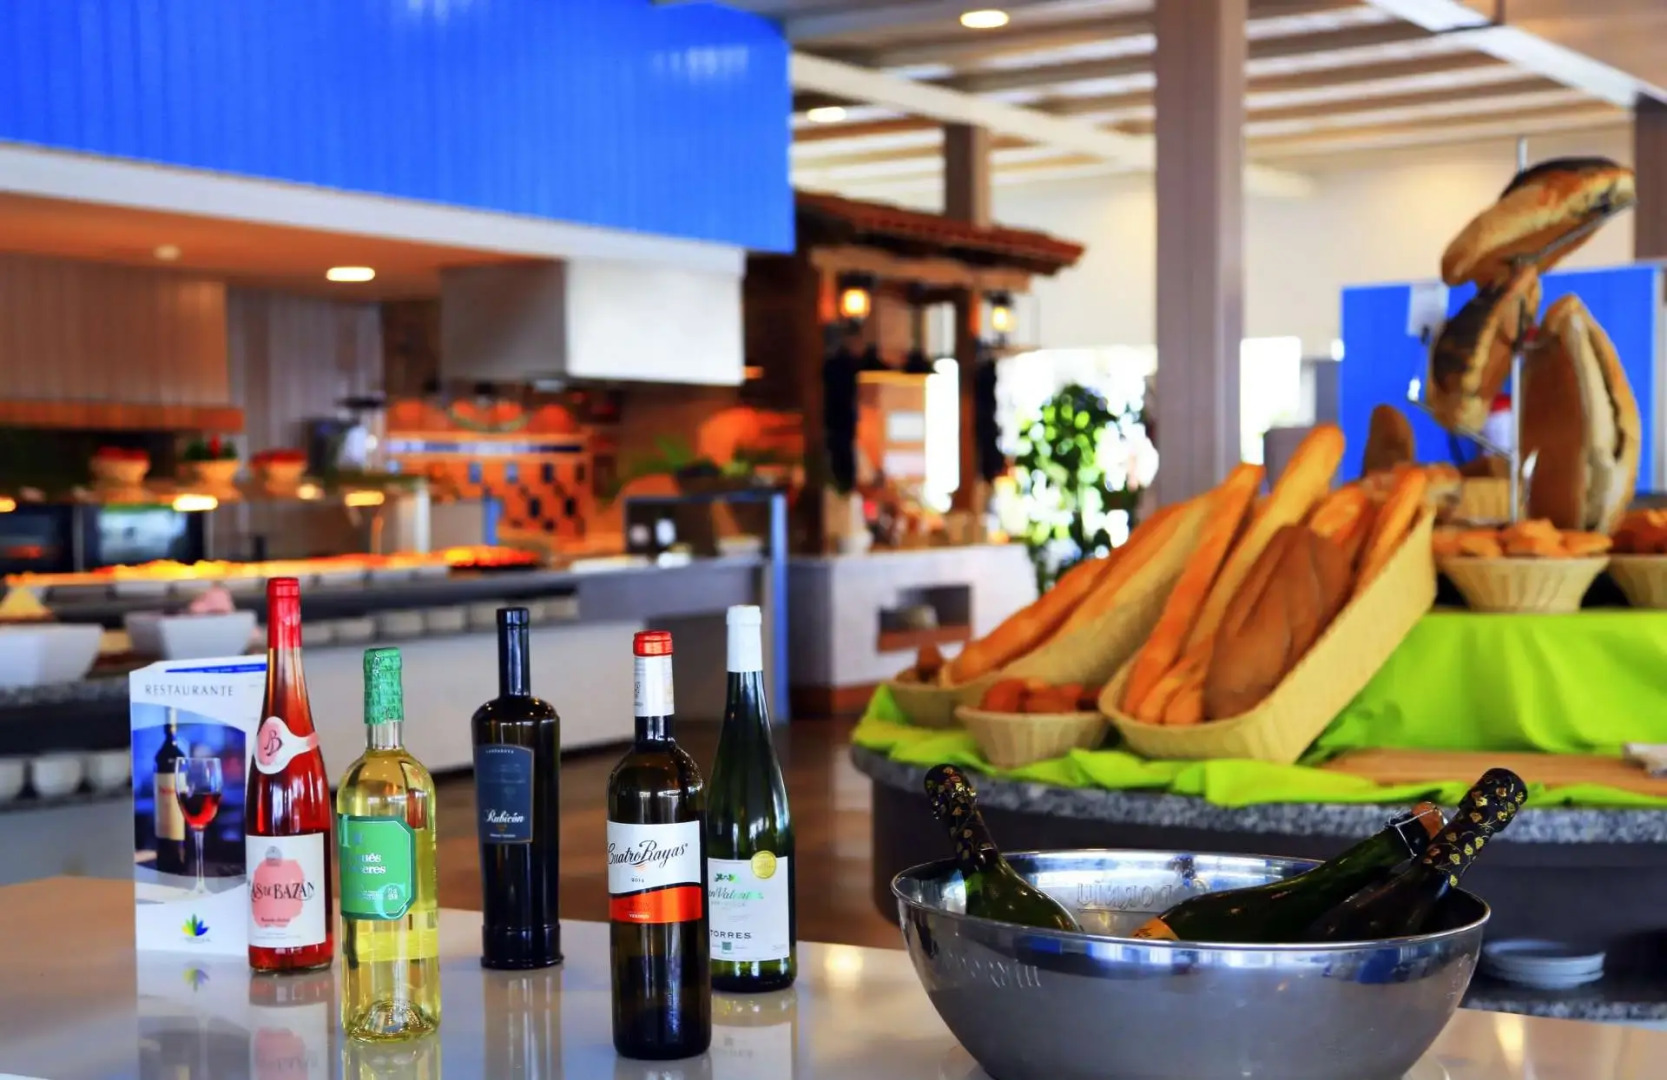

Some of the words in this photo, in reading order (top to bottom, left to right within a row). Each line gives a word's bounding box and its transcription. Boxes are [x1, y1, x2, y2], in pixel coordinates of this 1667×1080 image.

[145, 684, 234, 696] RESTAURANTE
[486, 808, 524, 823] Rubicón
[608, 842, 641, 865] Cuatro
[710, 929, 752, 939] TORRES
